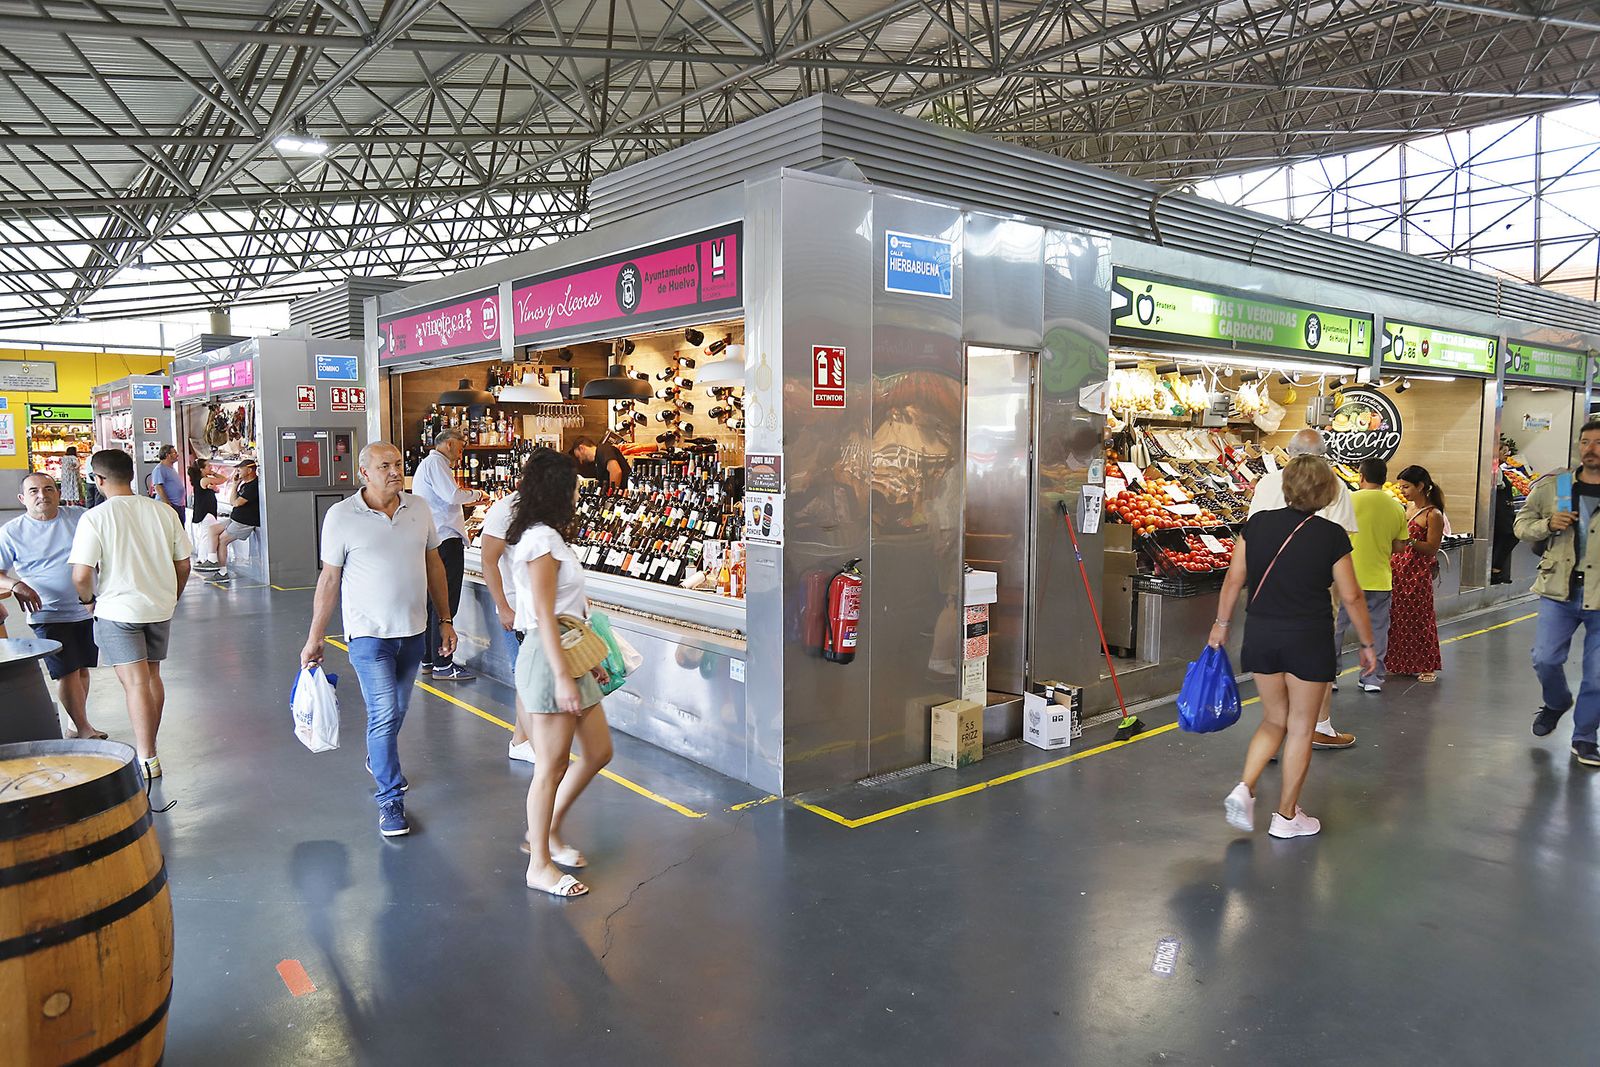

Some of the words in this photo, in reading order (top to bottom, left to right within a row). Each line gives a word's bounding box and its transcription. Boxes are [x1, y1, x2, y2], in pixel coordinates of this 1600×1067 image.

[645, 263, 697, 284] Ayuntamiento
[890, 257, 940, 277] HIERBABUENA
[657, 283, 667, 294] de
[669, 279, 697, 293] Huelva
[517, 292, 546, 324] Vinos
[545, 304, 556, 329] y
[557, 284, 603, 317] Licores
[1247, 305, 1298, 328] VERDURAS
[1219, 319, 1274, 342] GARROCHO
[318, 365, 340, 373] COMINO
[816, 394, 844, 402] EXTINTOR
[961, 729, 978, 743] FRIZZ
